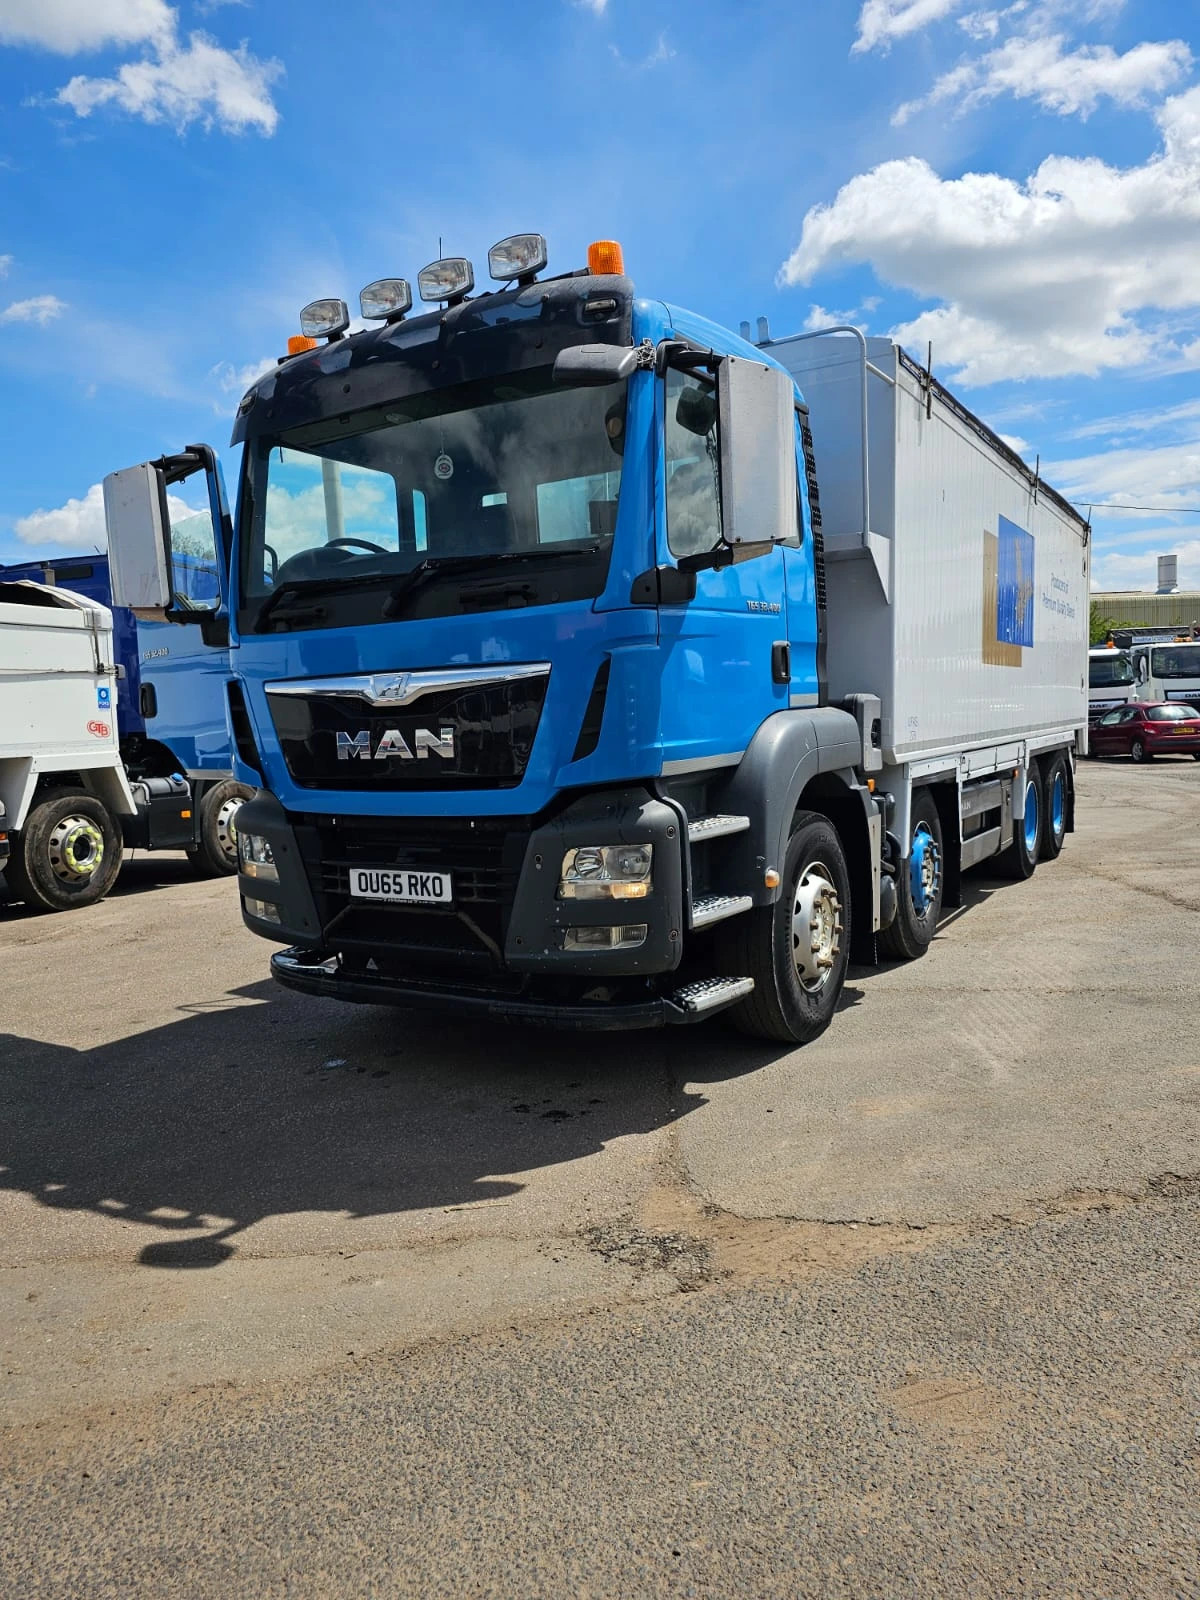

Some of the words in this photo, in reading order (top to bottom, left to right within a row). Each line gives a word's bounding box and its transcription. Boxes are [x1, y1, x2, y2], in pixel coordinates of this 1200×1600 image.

[89, 721, 109, 736] GTB
[336, 728, 455, 759] MAN
[358, 872, 403, 895] OU65
[408, 874, 443, 897] RKO
